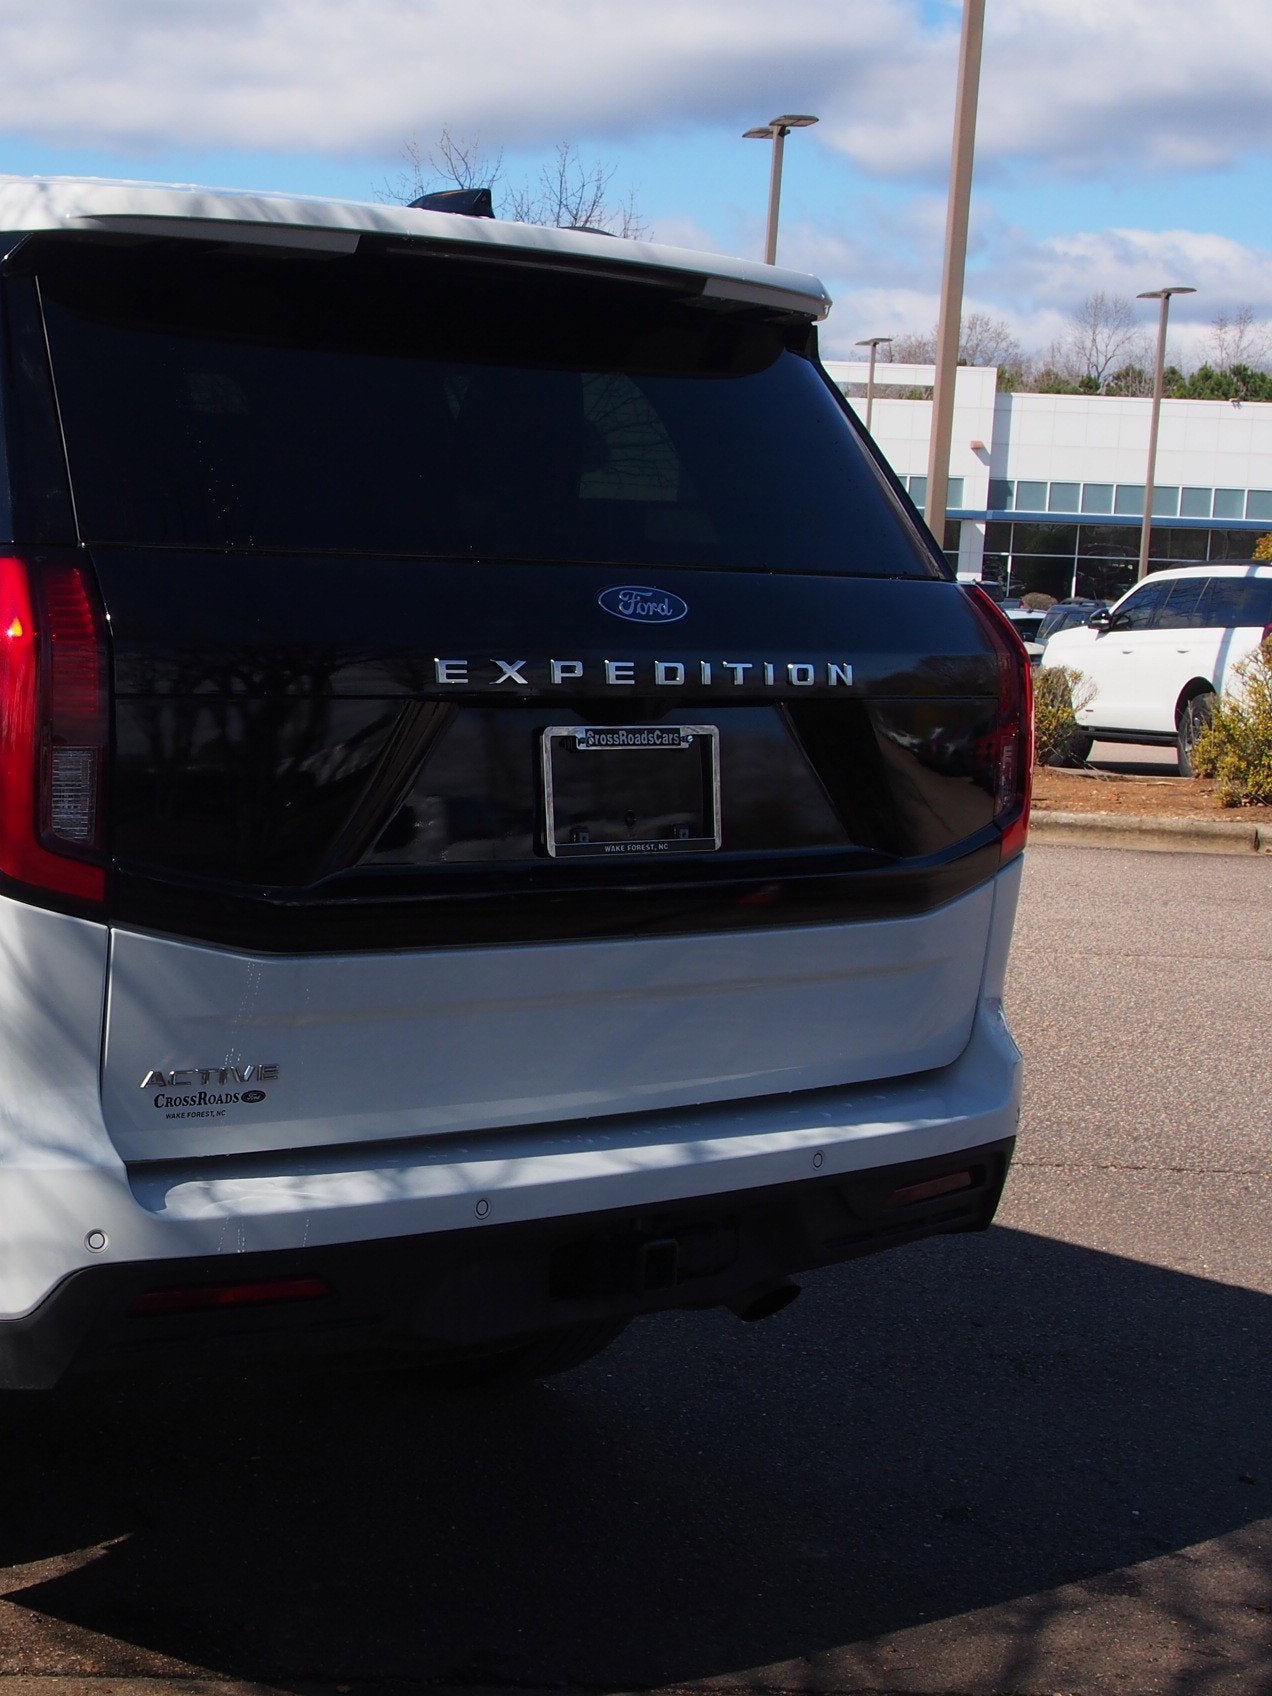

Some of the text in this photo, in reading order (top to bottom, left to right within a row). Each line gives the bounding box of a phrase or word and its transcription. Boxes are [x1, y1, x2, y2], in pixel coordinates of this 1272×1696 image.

[616, 588, 675, 618] Ford
[433, 657, 854, 687] EXPEDITION
[604, 842, 669, 853] WAKE FOREST, NC
[139, 1063, 279, 1089] ACTIVE
[165, 1109, 227, 1120] WAKE FOREST, NC
